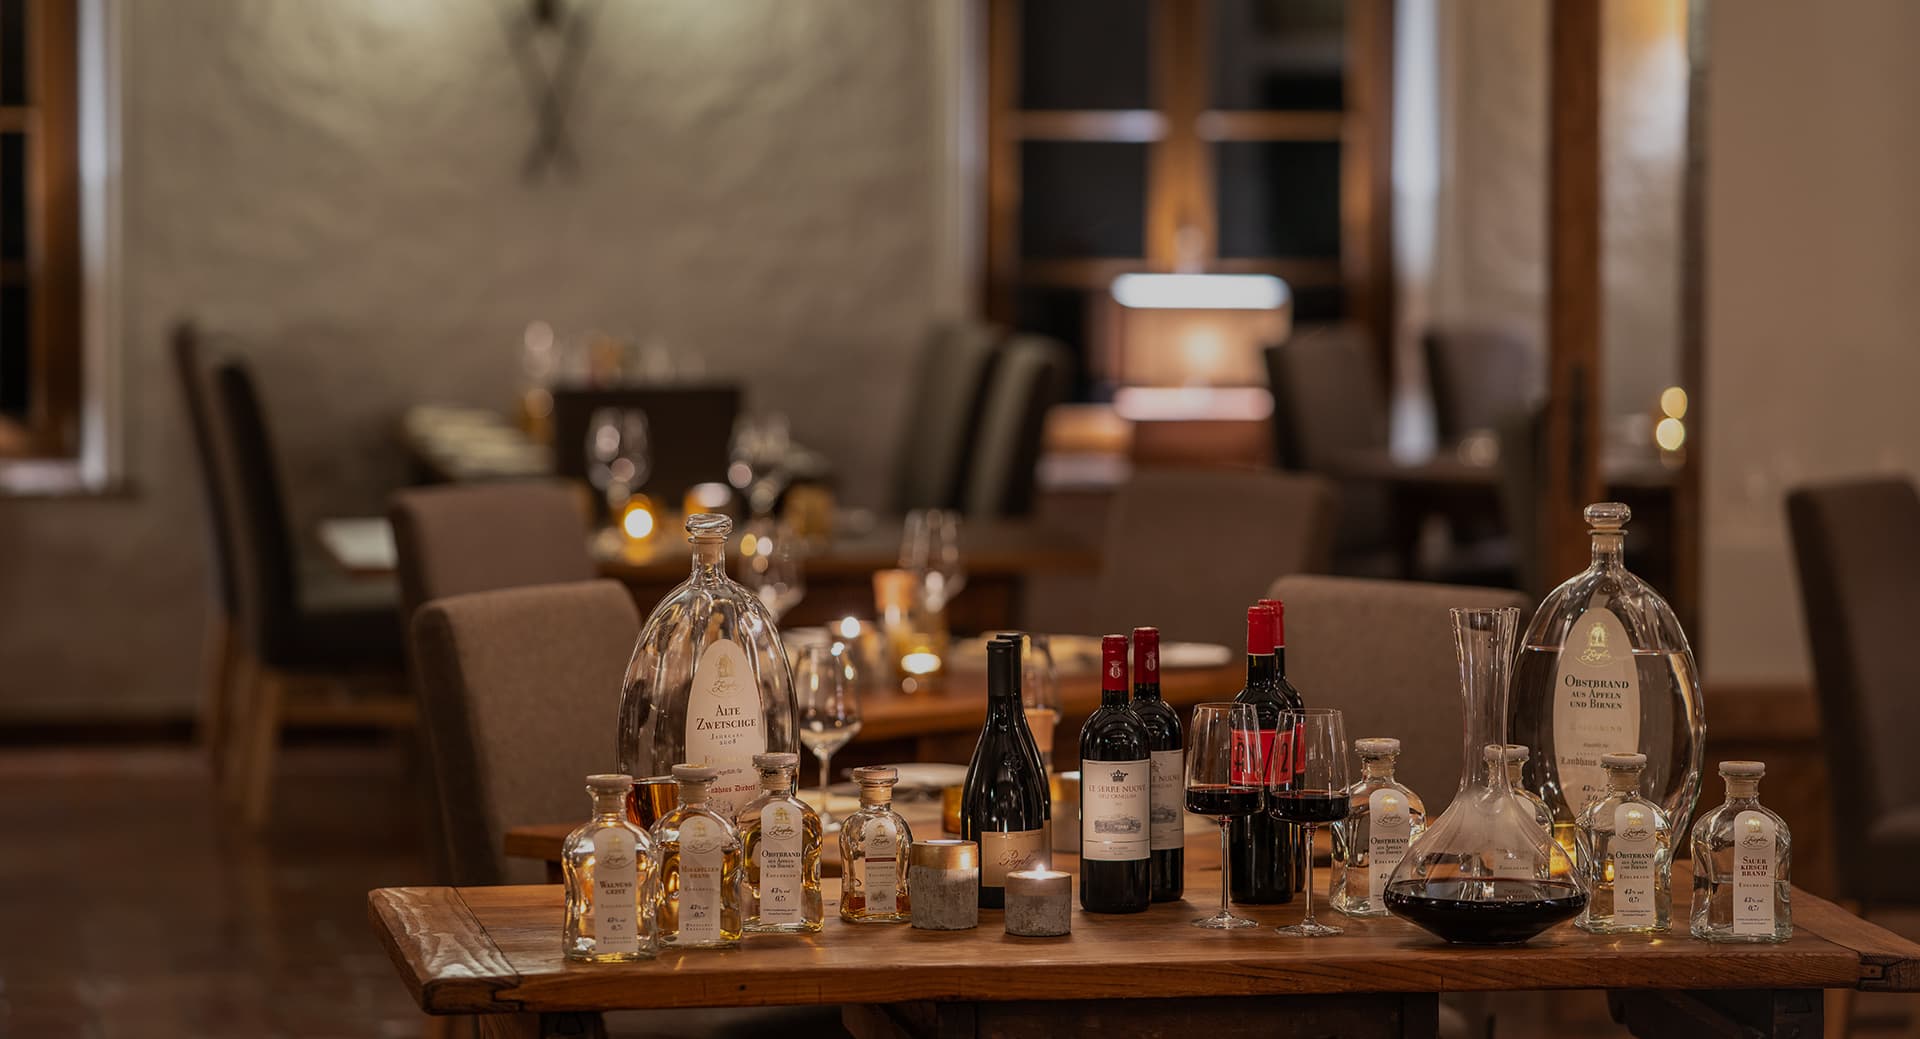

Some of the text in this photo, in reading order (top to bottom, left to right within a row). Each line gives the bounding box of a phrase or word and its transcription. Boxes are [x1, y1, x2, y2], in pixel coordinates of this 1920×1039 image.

[1564, 673, 1630, 689] OBSTBRAND
[715, 704, 741, 717] ALTE
[1590, 699, 1622, 709] BIRNEN
[696, 717, 757, 730] ZWETSCHGE
[1742, 855, 1767, 865] SAUER
